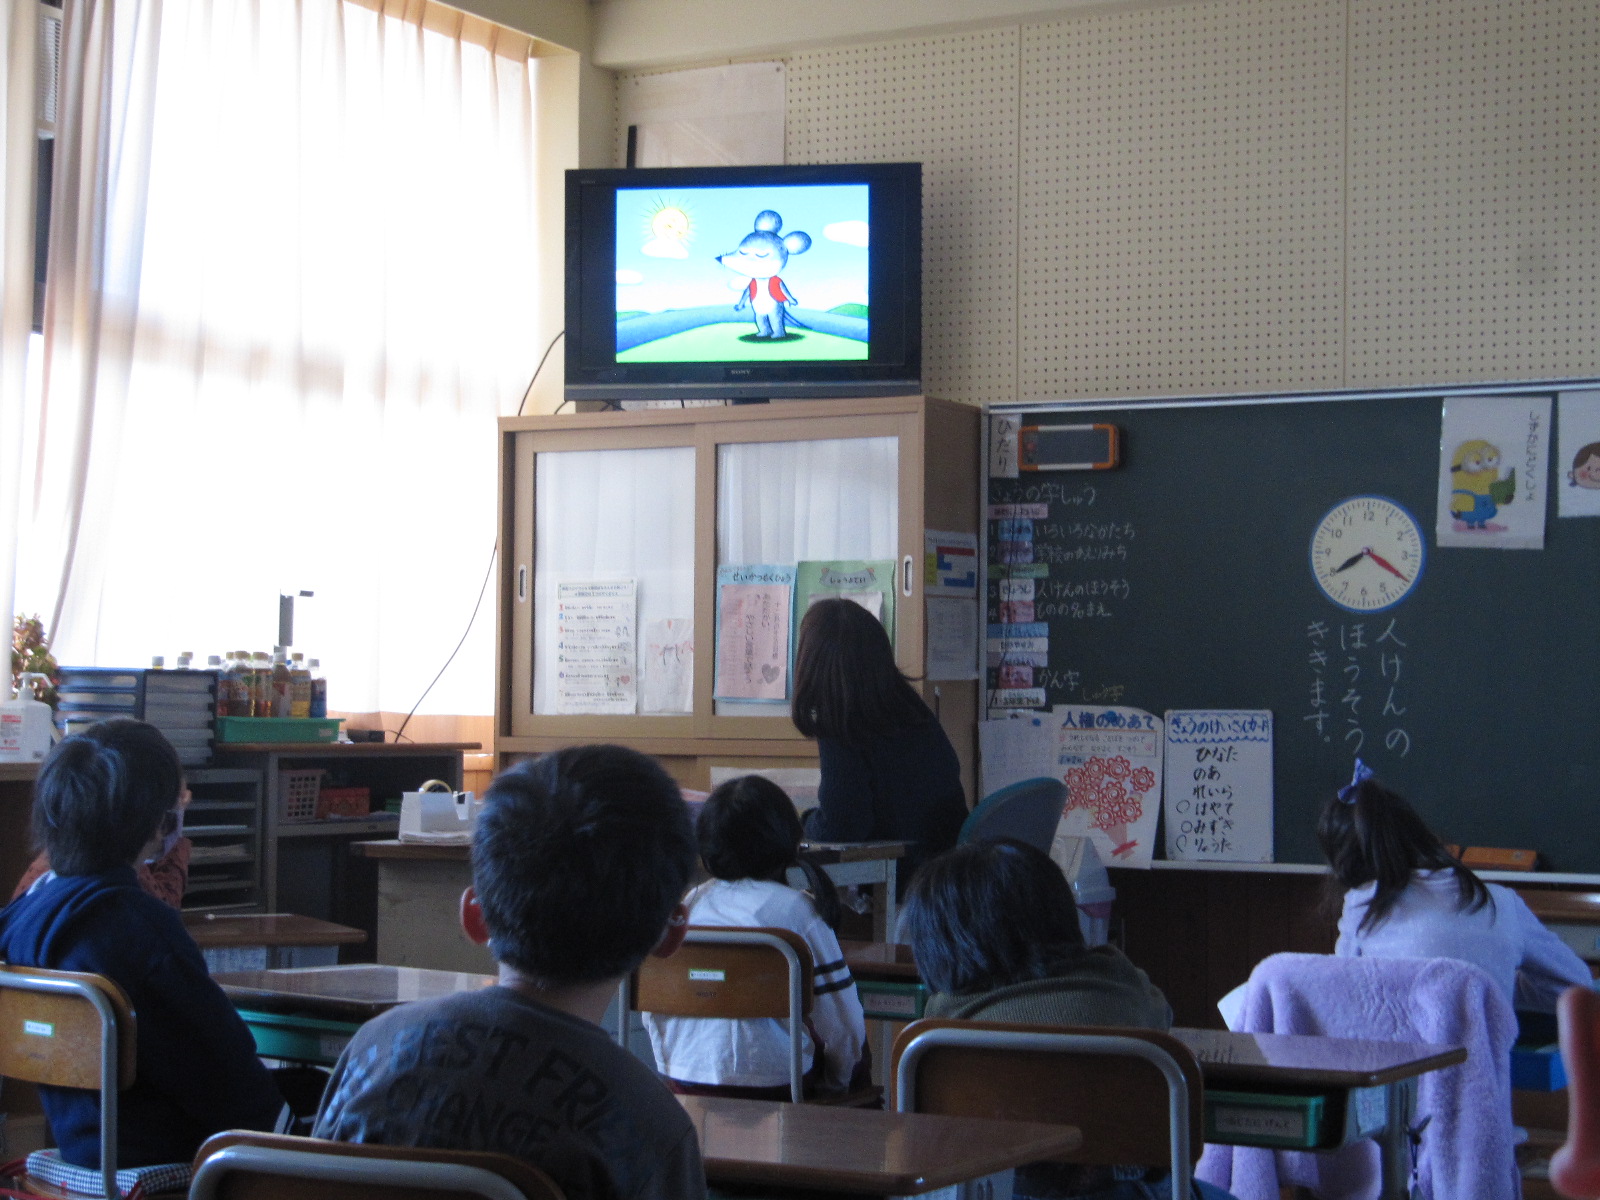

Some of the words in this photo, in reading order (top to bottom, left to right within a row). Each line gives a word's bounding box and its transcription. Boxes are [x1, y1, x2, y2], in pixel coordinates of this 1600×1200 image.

[1035, 579, 1131, 600] 人けんのほうそう
[1340, 622, 1369, 756] ほうそう
[1375, 617, 1411, 758] 人けんの
[1195, 745, 1240, 763] ひなた
[1192, 764, 1221, 782] のあ
[1195, 801, 1234, 817] はやて
